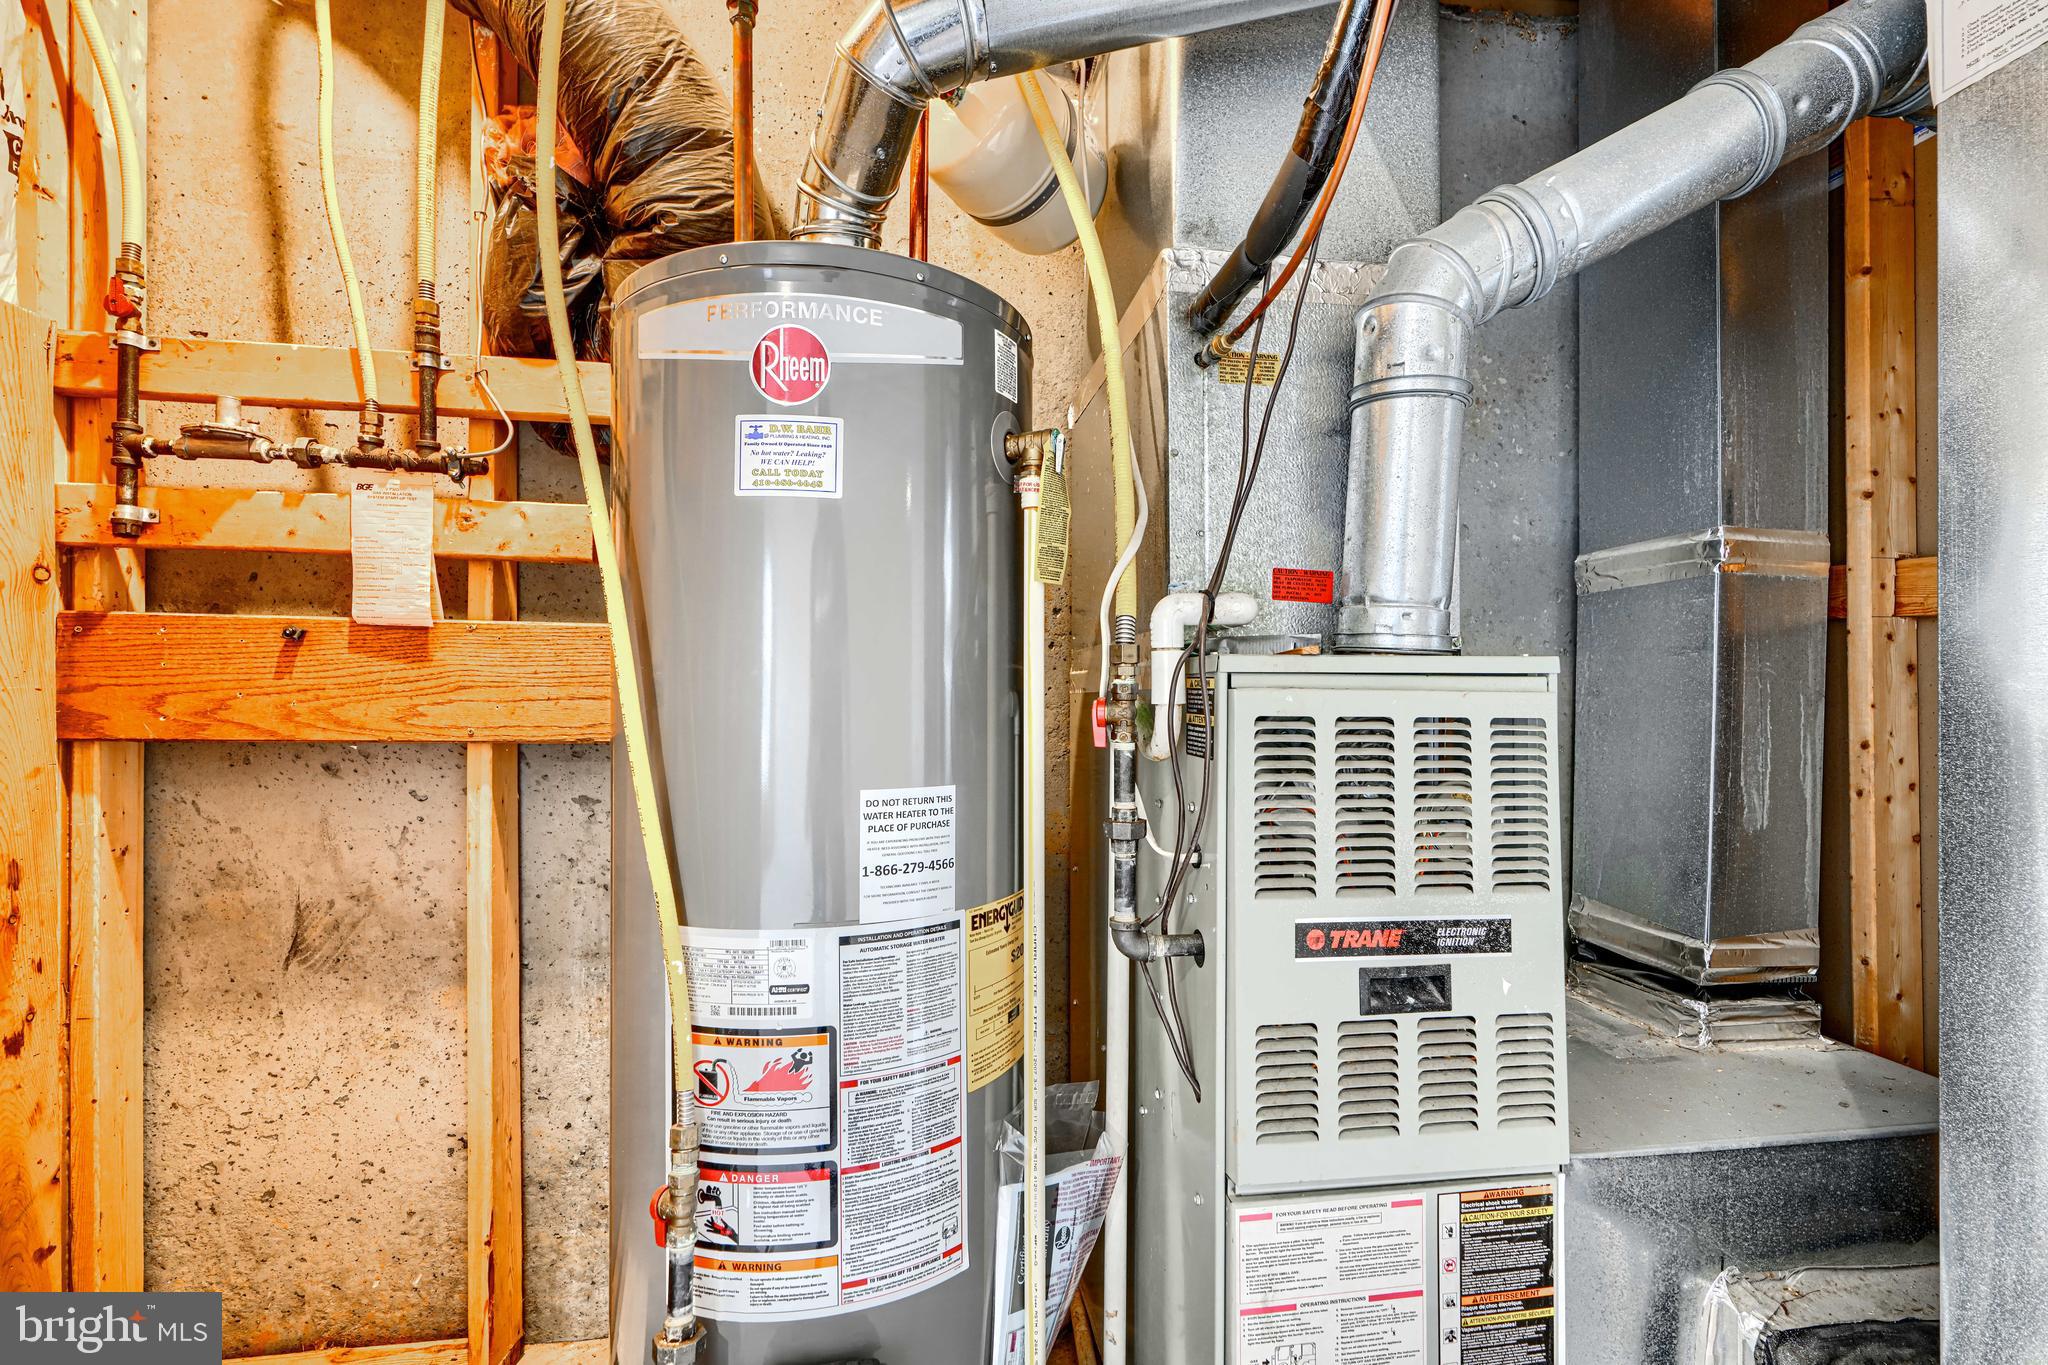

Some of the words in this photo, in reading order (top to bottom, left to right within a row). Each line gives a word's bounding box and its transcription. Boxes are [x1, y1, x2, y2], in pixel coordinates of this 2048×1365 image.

[707, 300, 883, 326] PERFORMANCE
[761, 326, 826, 392] Rheem
[769, 424, 793, 433] D.W.
[752, 468, 781, 476] CALL
[784, 469, 824, 478] TODAY
[356, 483, 374, 491] BGE
[882, 799, 900, 807] NOT
[902, 797, 934, 805] RETURN
[936, 795, 952, 803] THIS
[863, 812, 894, 820] WATER
[896, 809, 926, 819] HEATER
[929, 808, 938, 816] TO
[941, 807, 954, 815] THE
[868, 824, 894, 833] PLACE
[897, 823, 908, 831] OF
[910, 820, 950, 830] PURCHASE
[862, 857, 954, 877] 1-866-279-4566
[858, 934, 892, 942] INSTALLATION
[904, 929, 930, 937] OPERATION
[1330, 929, 1405, 949] TRANE
[1437, 927, 1487, 937] ELECTRONIC
[1437, 937, 1475, 947] IGNITION
[860, 945, 889, 953] AUTOMATIC
[726, 1038, 783, 1046] WARNING
[911, 1068, 925, 1076] BEFORE
[926, 1062, 946, 1072] OPERATING
[882, 1159, 901, 1167] LIGHTING
[901, 1151, 929, 1162] INSTRUCTIONS
[1090, 1156, 1121, 1167] IMPORTANT
[731, 1174, 779, 1183] DANGER
[1489, 1189, 1524, 1198] WARNING
[1359, 1202, 1387, 1210] OPERATING
[732, 1263, 782, 1271] WARNING
[921, 1256, 941, 1268] APPLIANCE
[1300, 1299, 1329, 1308] OPERATING
[1329, 1296, 1366, 1305] INSTRUCTIONS
[1479, 1290, 1540, 1302] AVERTISSEMENT
